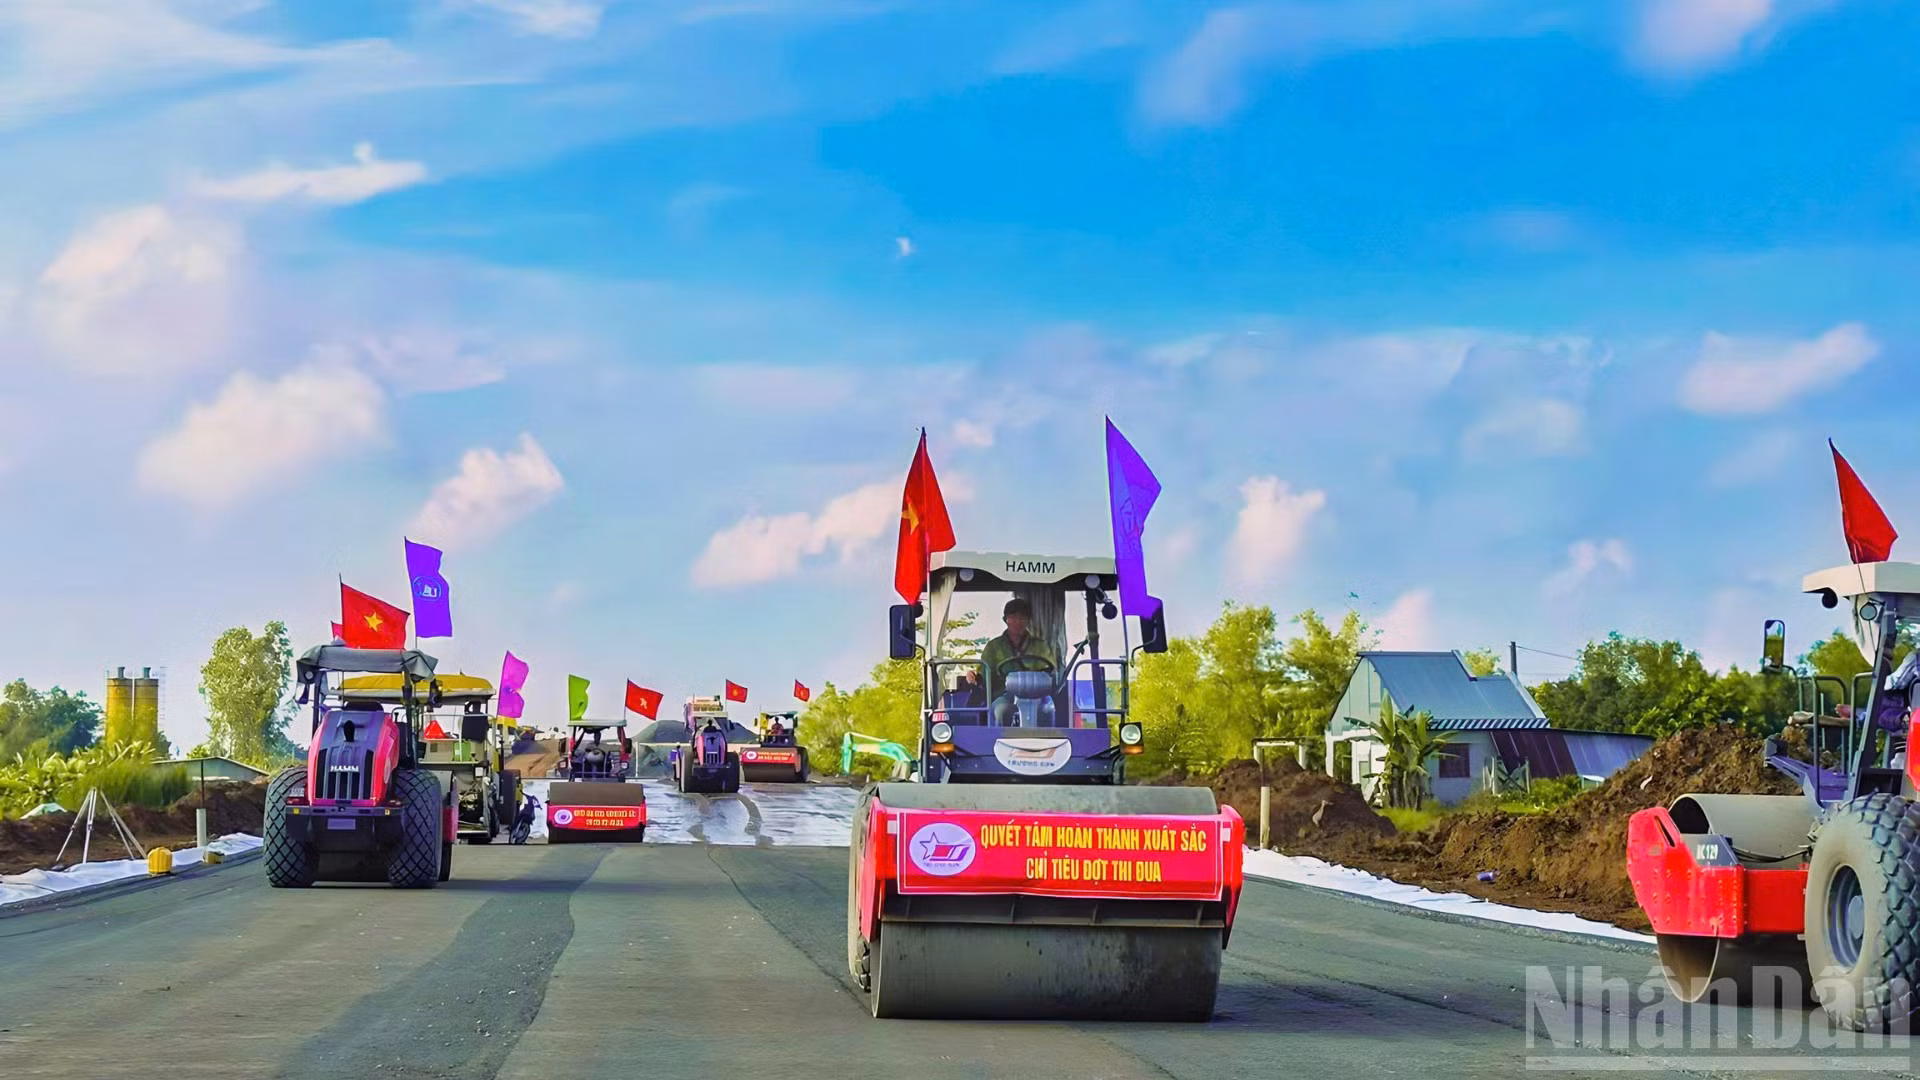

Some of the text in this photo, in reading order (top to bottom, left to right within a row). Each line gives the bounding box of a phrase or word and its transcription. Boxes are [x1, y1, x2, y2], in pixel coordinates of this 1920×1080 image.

[1005, 560, 1056, 574] HAMM
[980, 818, 1207, 852] QUYẾT TÂM HOÀN THÀNH XUẤT SẮC
[1026, 850, 1162, 885] CHỈ TIÊU ĐỢT THI ĐUA
